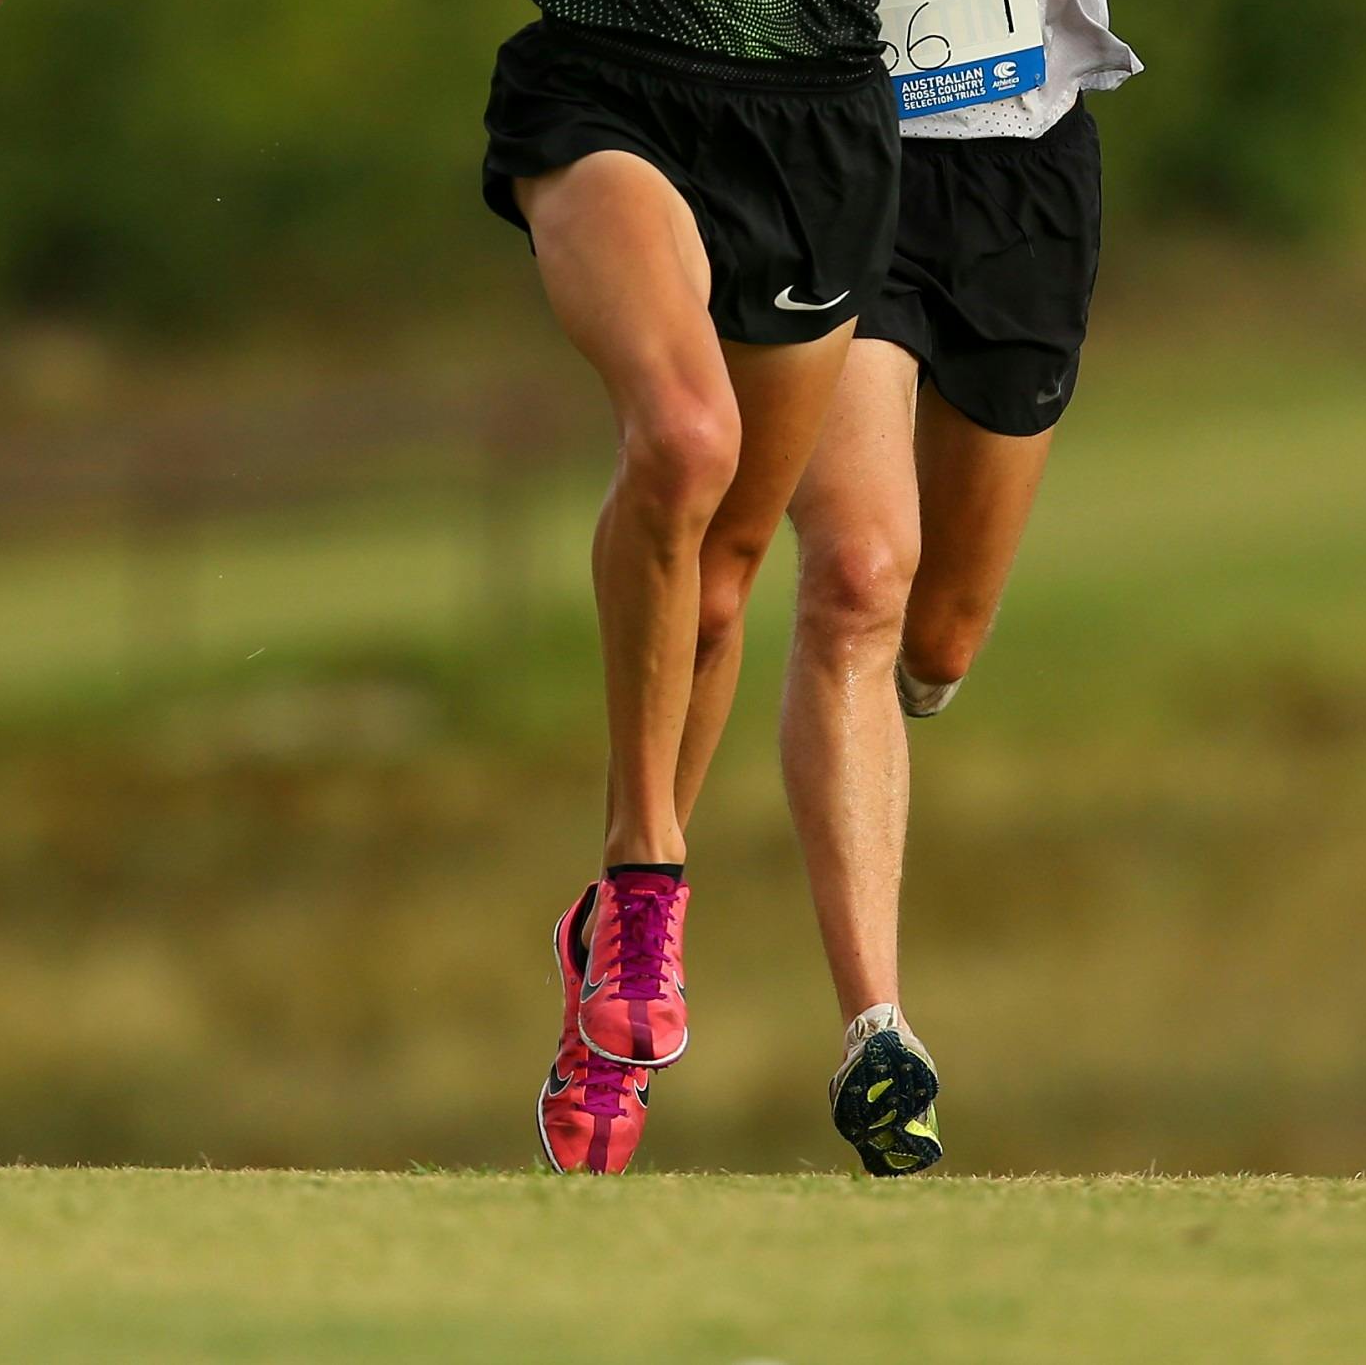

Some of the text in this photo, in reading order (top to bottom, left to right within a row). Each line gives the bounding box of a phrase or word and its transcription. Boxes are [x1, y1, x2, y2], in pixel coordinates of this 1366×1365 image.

[901, 67, 984, 93] AUSTRALIAN
[902, 89, 936, 102] CROSS
[937, 78, 984, 96] COUNTRY
[904, 95, 954, 111] SELECTION
[956, 87, 987, 101] TRIALS
